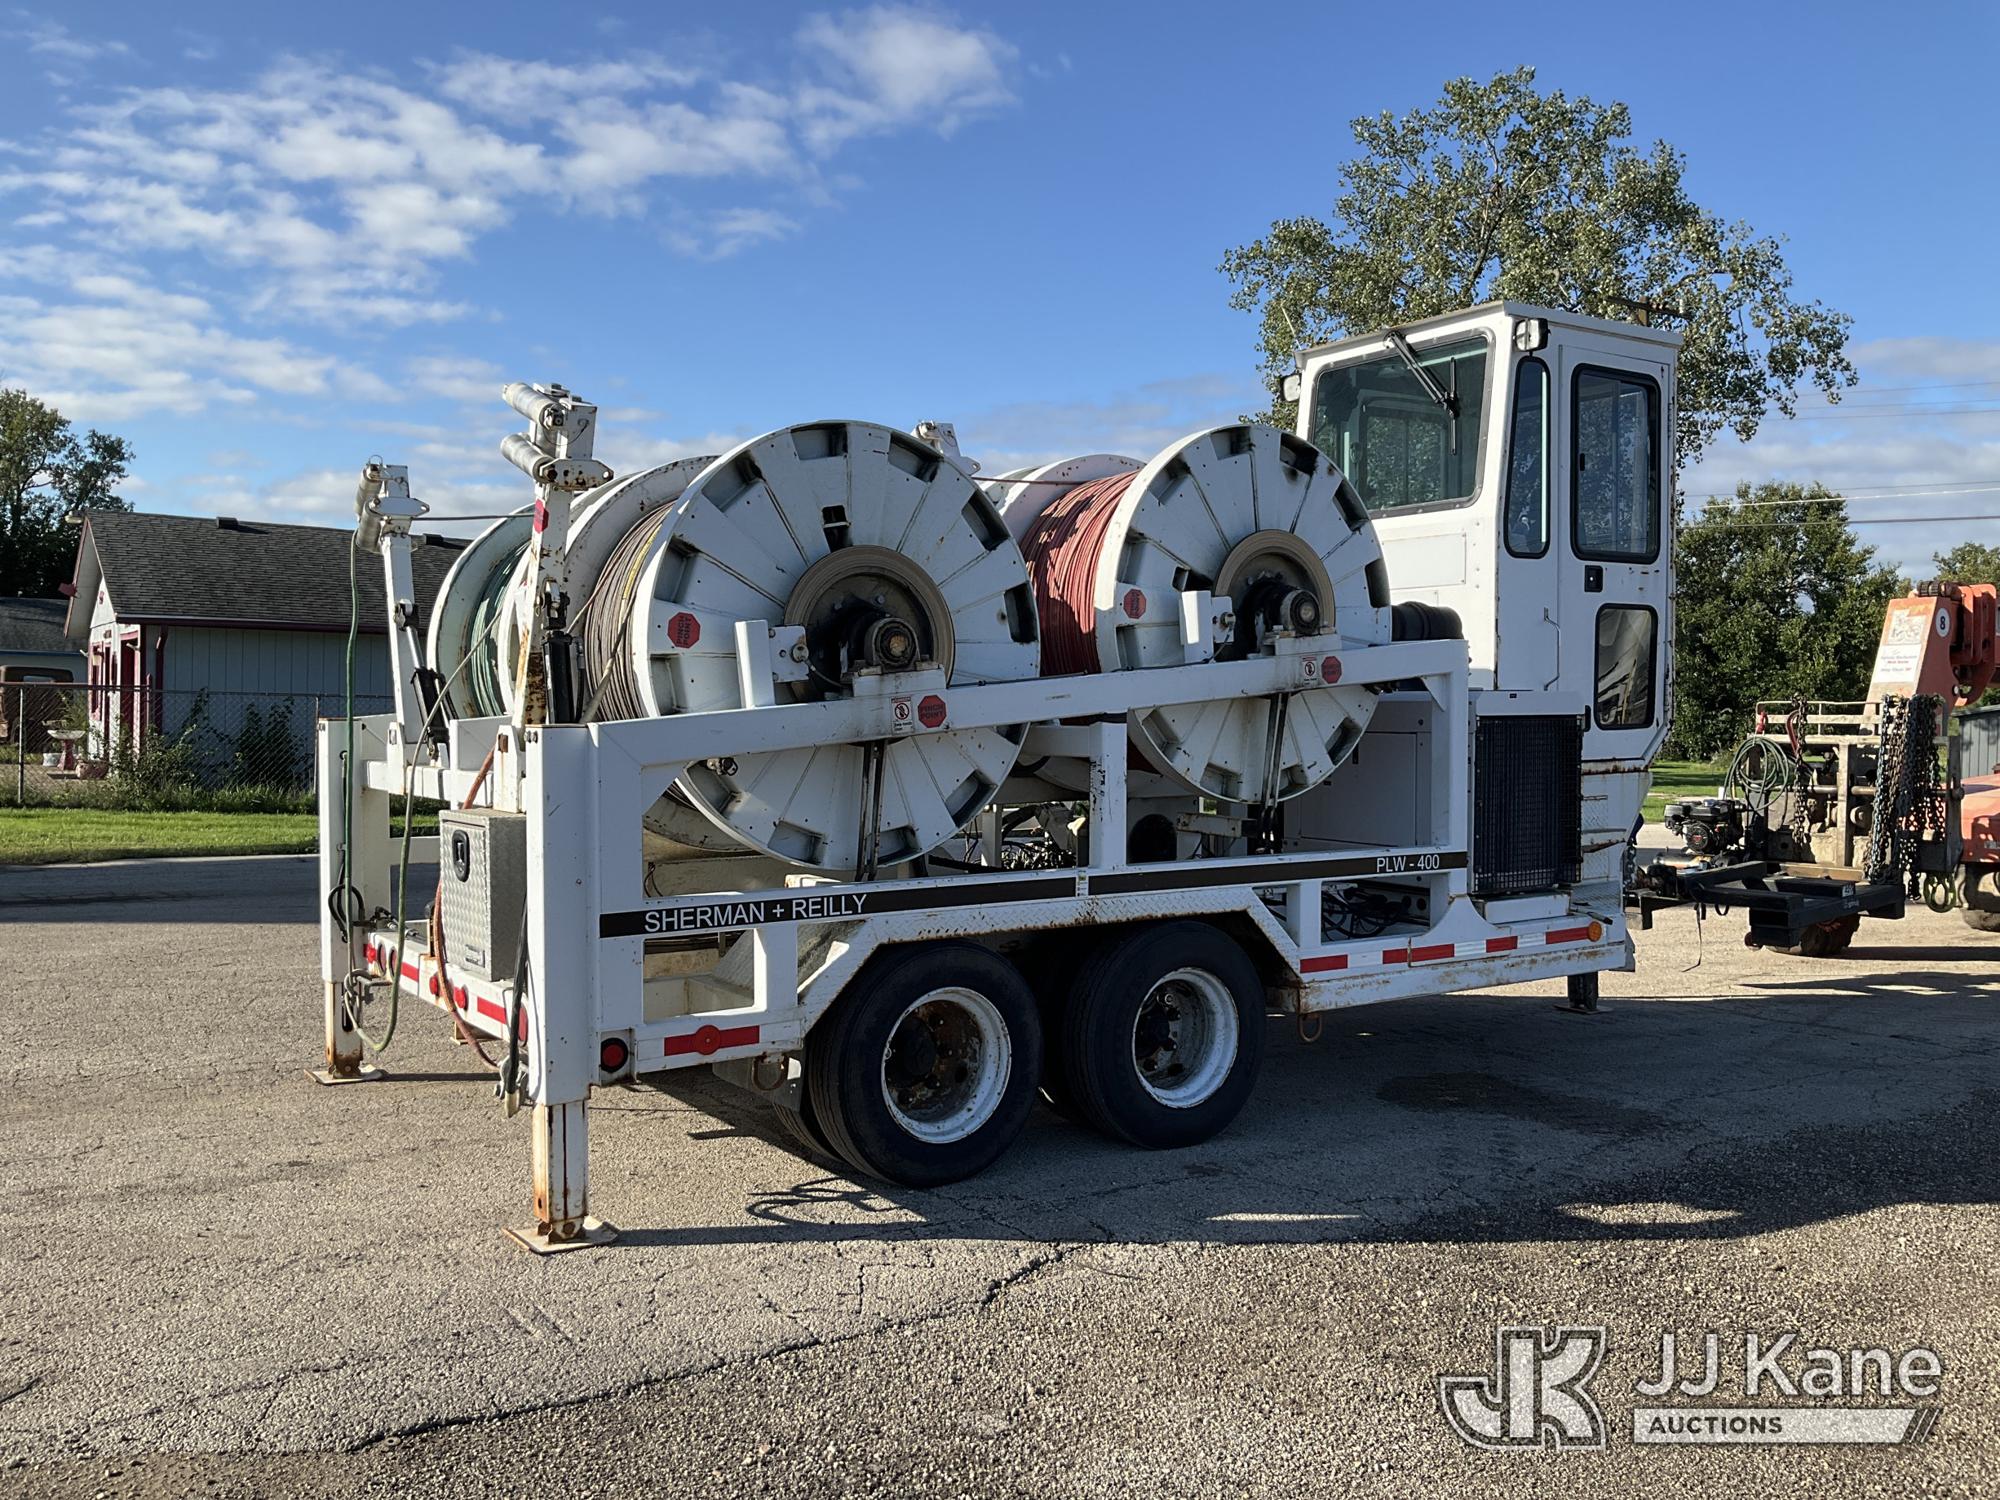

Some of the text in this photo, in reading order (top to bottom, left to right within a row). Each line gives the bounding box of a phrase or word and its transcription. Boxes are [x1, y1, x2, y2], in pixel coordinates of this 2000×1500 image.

[1939, 615, 1946, 630] 8
[920, 711, 944, 720] POINT
[1376, 855, 1407, 873] PLW
[1417, 854, 1440, 870] 400
[644, 894, 868, 933] SHERMAN + REILLY
